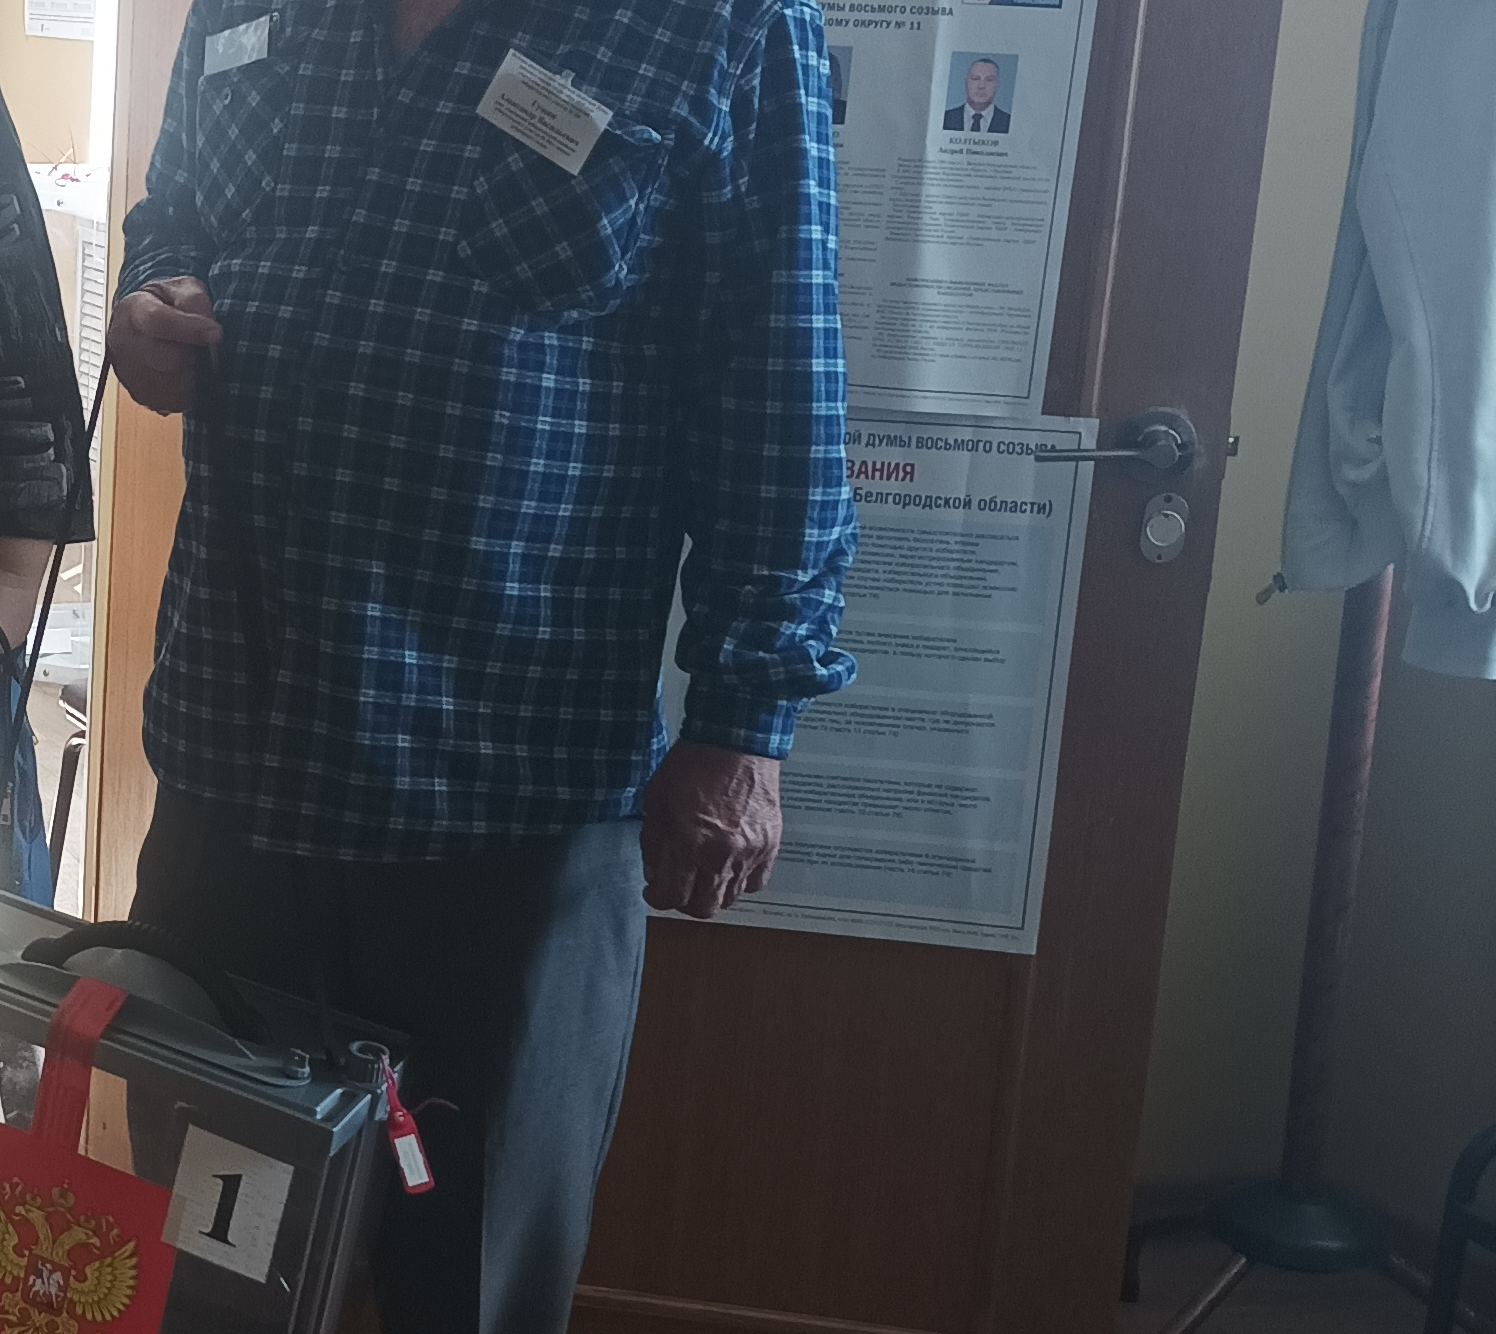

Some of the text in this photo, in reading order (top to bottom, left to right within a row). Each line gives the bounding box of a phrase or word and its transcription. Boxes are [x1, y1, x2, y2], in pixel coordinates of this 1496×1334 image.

[848, 3, 907, 15] ВОСЬМОГО
[909, 5, 954, 17] СОЗЫВА
[852, 19, 892, 29] ОКРУГУ
[909, 21, 921, 31] 11
[865, 433, 912, 448] ДУМЫ
[915, 435, 993, 454] ВОСЬМОГО
[853, 487, 1053, 517] Белгородской области)
[197, 1172, 245, 1248] 1
